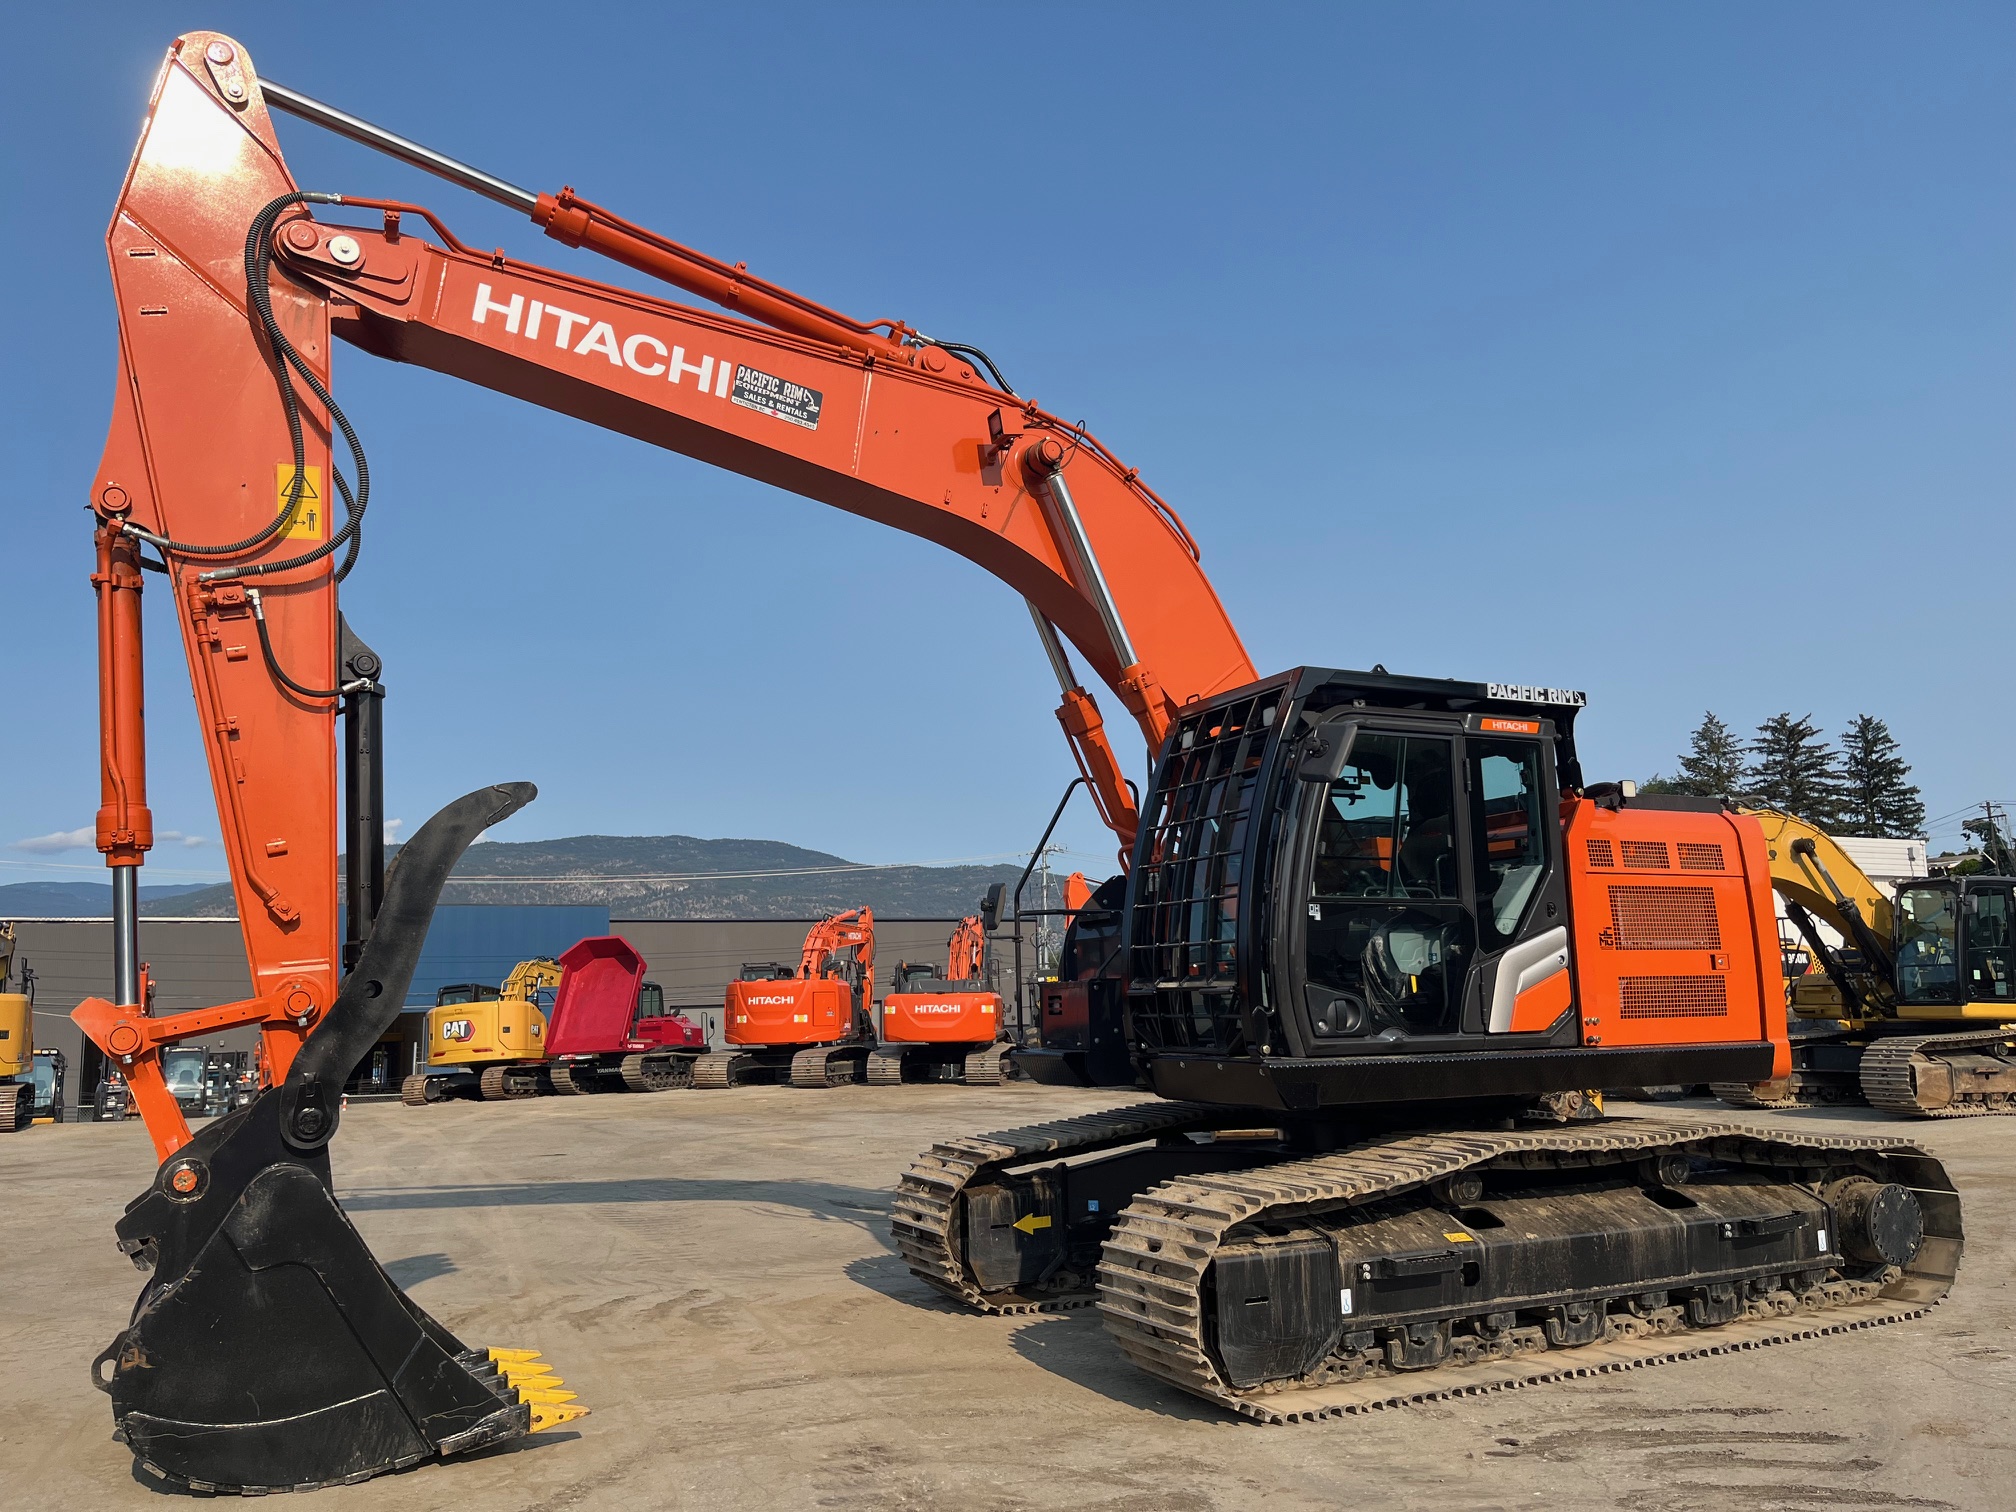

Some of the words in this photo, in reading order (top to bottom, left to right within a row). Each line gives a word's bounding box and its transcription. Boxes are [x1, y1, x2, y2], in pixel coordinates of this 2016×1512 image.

[472, 282, 732, 399] HITACHI
[735, 380, 802, 407] EQUIPMENT
[737, 366, 780, 393] PACIFIC
[783, 382, 804, 401] RIM
[743, 391, 767, 405] SALES
[768, 400, 775, 408] &
[776, 403, 808, 419] RENTALS
[1487, 683, 1545, 702] PACIFIC
[1548, 689, 1576, 705] RIM
[1492, 721, 1528, 732] HITACHI
[748, 995, 794, 1005] HITACHI
[914, 1004, 961, 1014] HITACHI
[443, 1020, 468, 1039] CAT
